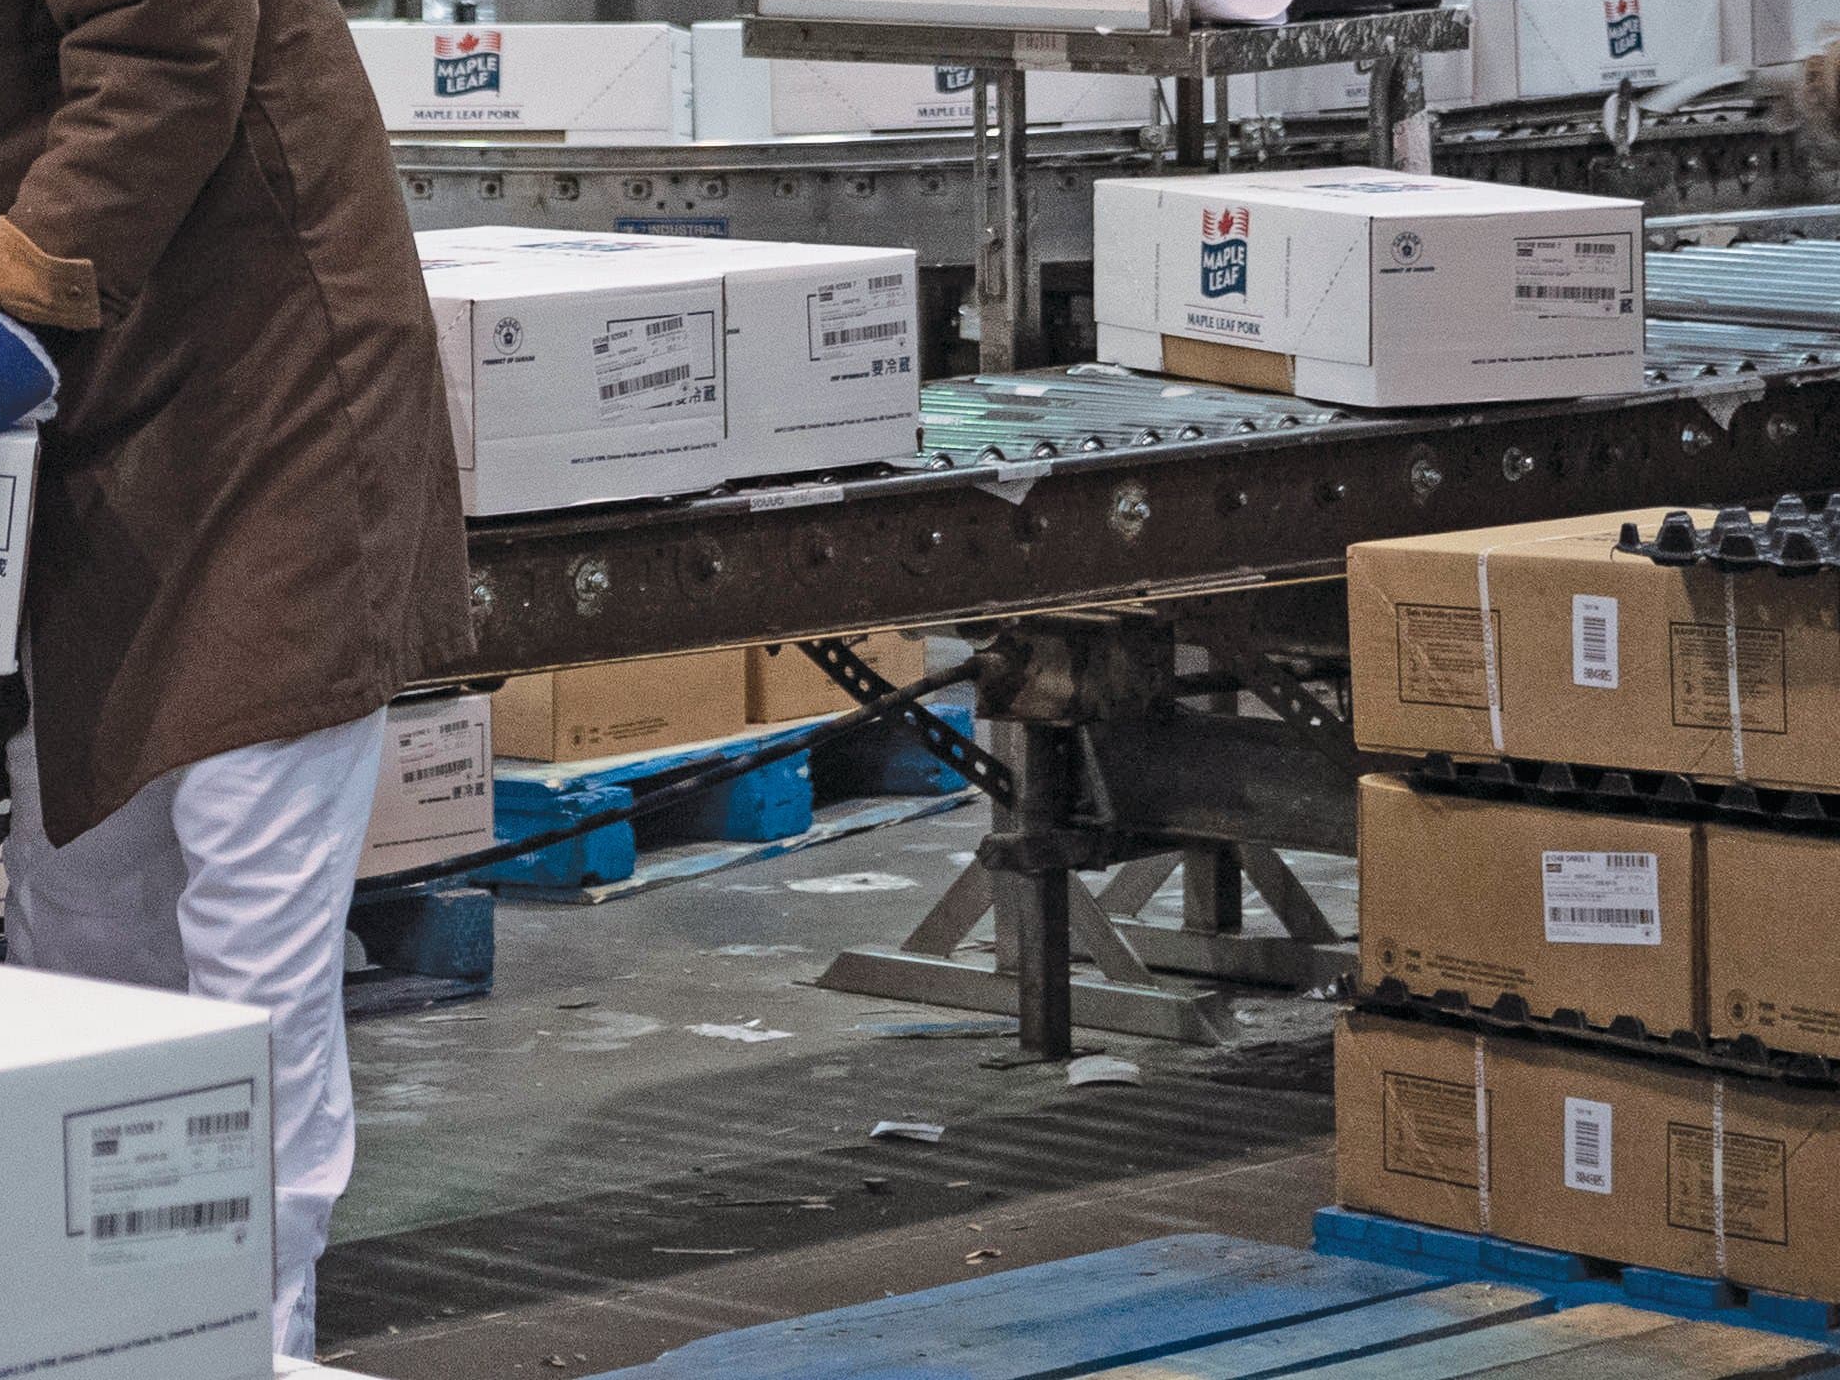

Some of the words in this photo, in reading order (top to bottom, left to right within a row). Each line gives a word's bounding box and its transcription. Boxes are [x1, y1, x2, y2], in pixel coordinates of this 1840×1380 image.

[437, 55, 497, 77] MAPLE
[446, 72, 489, 93] LEAF
[413, 110, 453, 119] MAPLE
[457, 110, 483, 119] LEAF
[487, 110, 520, 119] PORK
[917, 106, 955, 117] MAPLE
[1201, 242, 1246, 272] MAPLE
[1208, 266, 1240, 293] LEAF
[1187, 312, 1214, 329] MAPLE
[1215, 315, 1236, 331] LEAF
[1237, 318, 1261, 335] PORK
